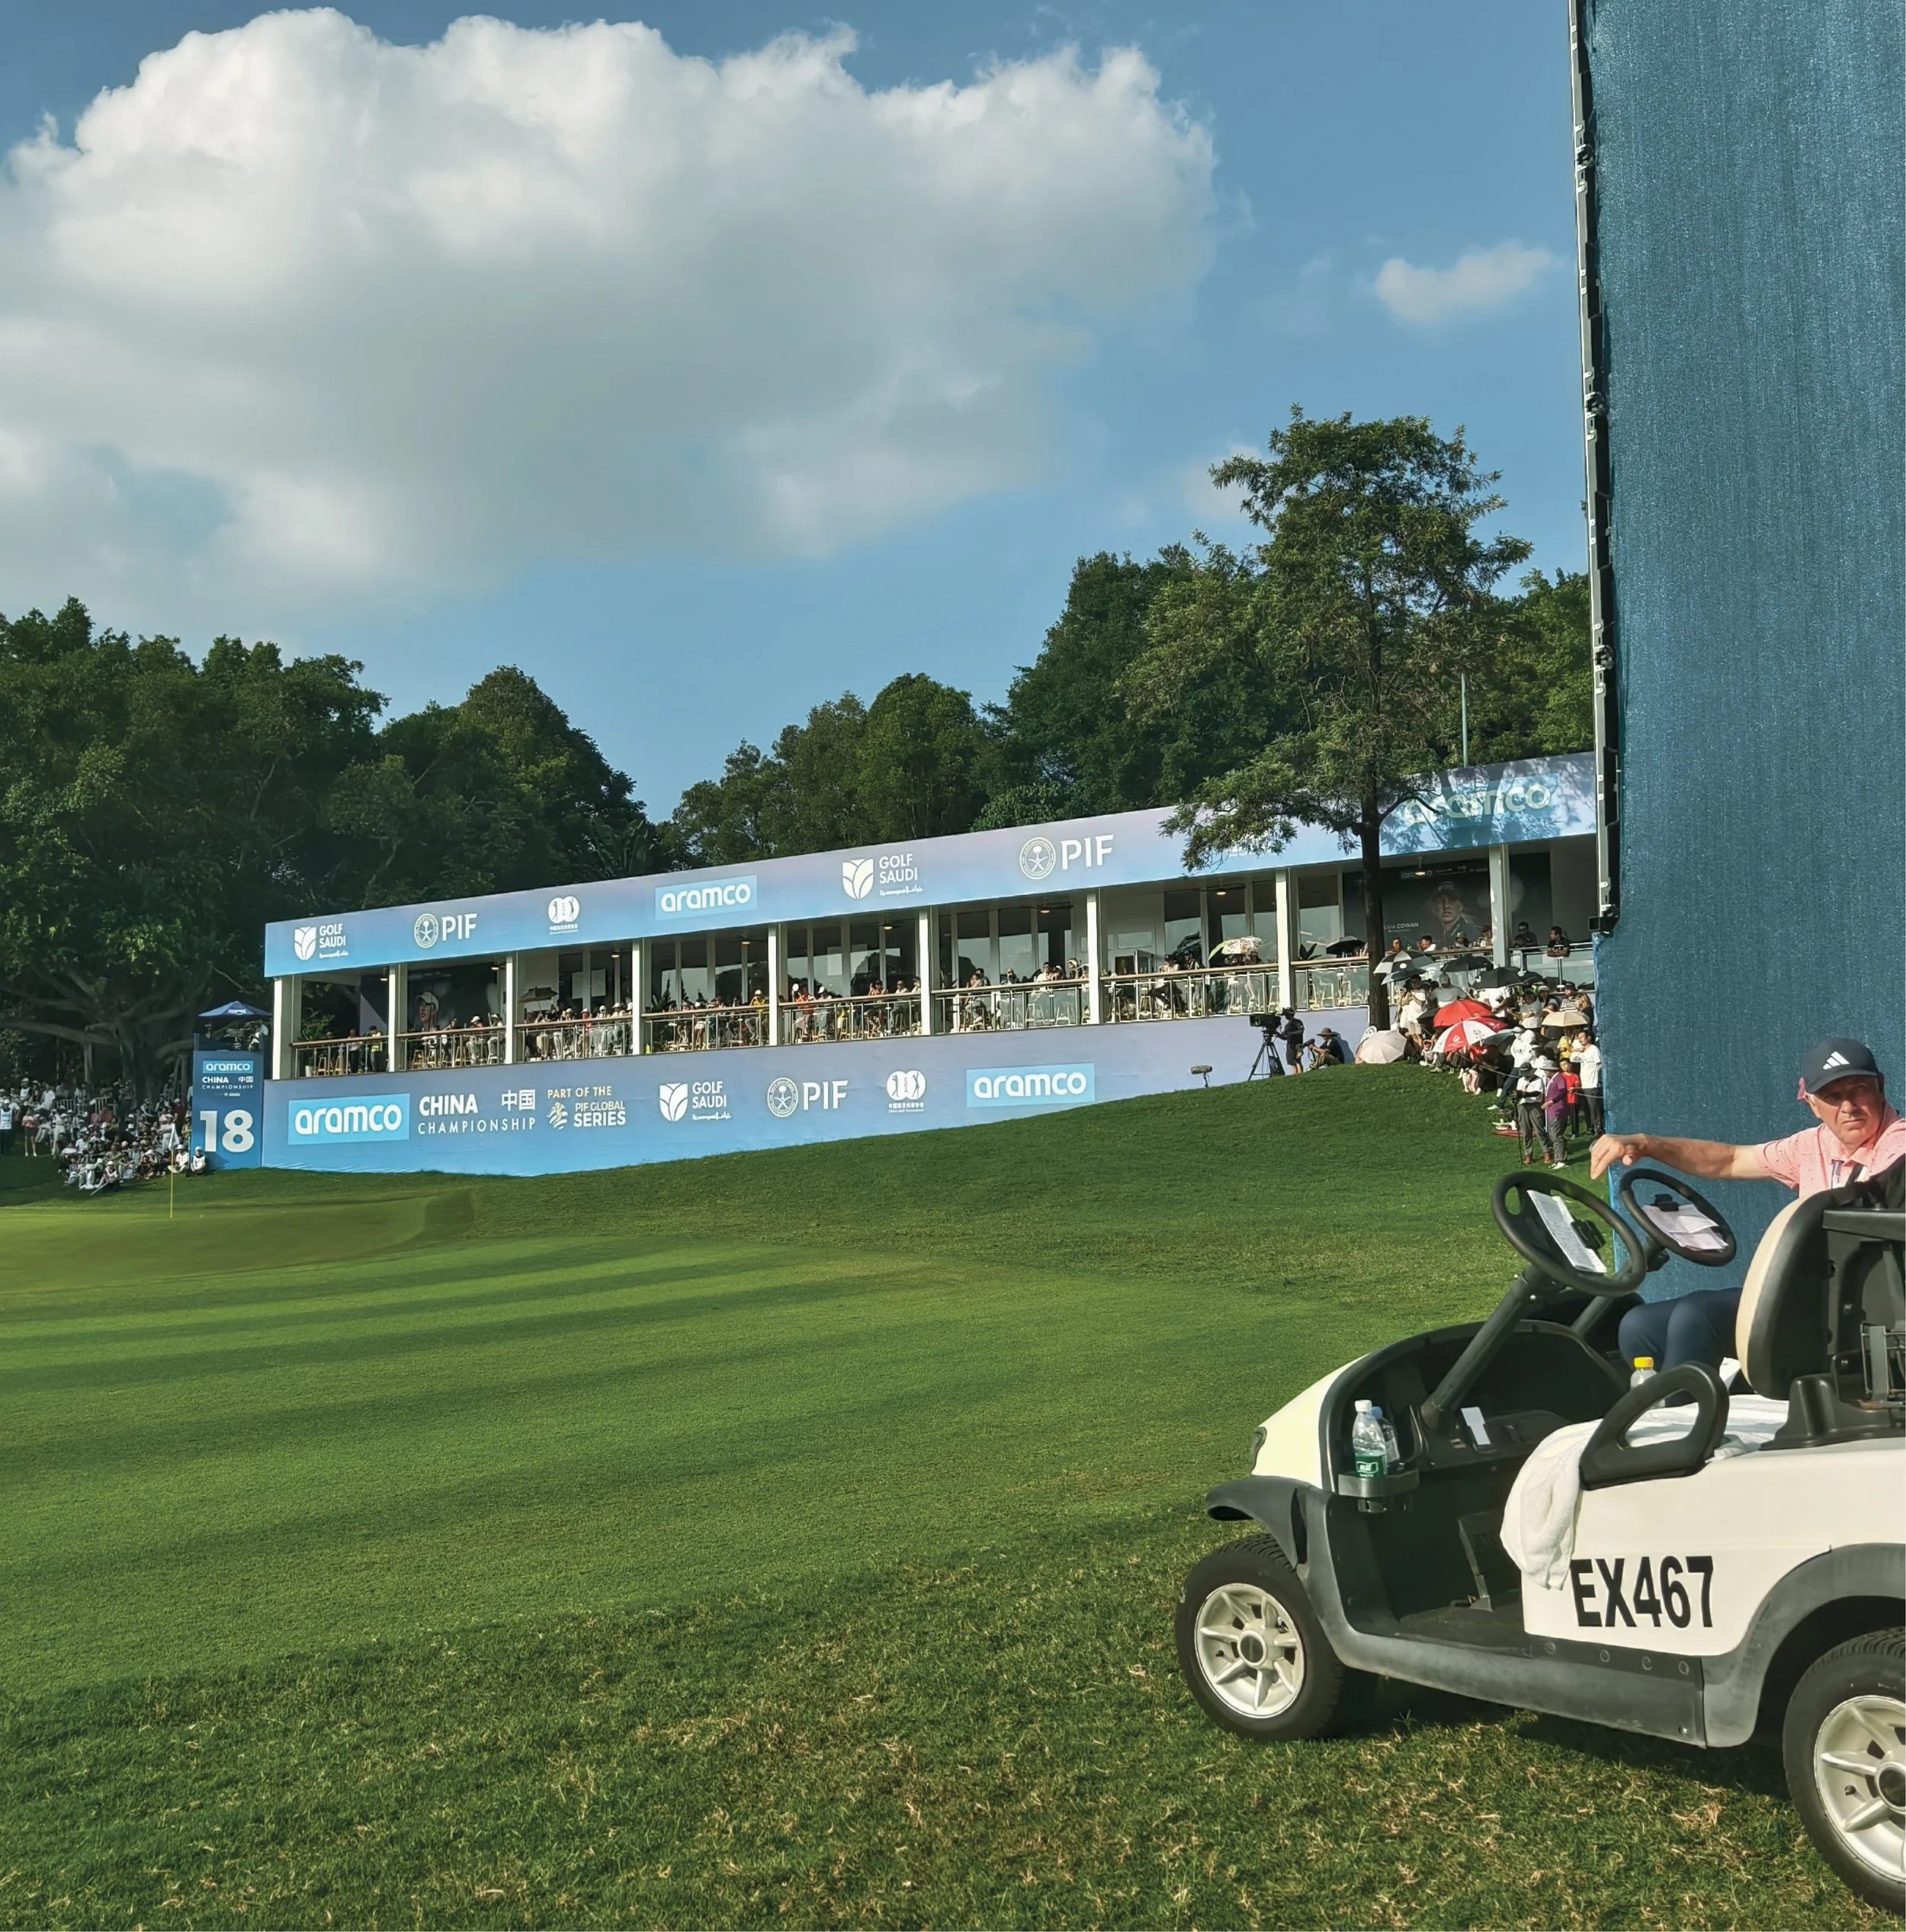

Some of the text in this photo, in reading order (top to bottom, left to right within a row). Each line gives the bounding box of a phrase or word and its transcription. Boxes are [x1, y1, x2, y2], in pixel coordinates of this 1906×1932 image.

[1060, 834, 1115, 870] PIF
[879, 853, 913, 869] GOLF
[879, 868, 918, 884] SAUDI
[661, 884, 751, 912] aramco
[319, 923, 343, 936] GOLF
[441, 913, 477, 942] PIF
[319, 935, 346, 948] SAUDI
[206, 1063, 251, 1071] aramco
[547, 1086, 612, 1099] PART OF THE
[692, 1080, 723, 1095] GOLF
[974, 1072, 1087, 1099] aramco
[501, 1089, 536, 1112] 中国
[692, 1094, 727, 1109] SAUDI
[802, 1080, 849, 1110] PIF
[419, 1093, 479, 1116] CHINA
[575, 1100, 626, 1112] PIF GLOBAL
[295, 1104, 402, 1134] aramco
[418, 1117, 536, 1134] CHAMPIONSHIP
[573, 1111, 626, 1128] SERIES
[200, 1109, 255, 1153] 18
[1569, 1555, 1714, 1629] EX467
